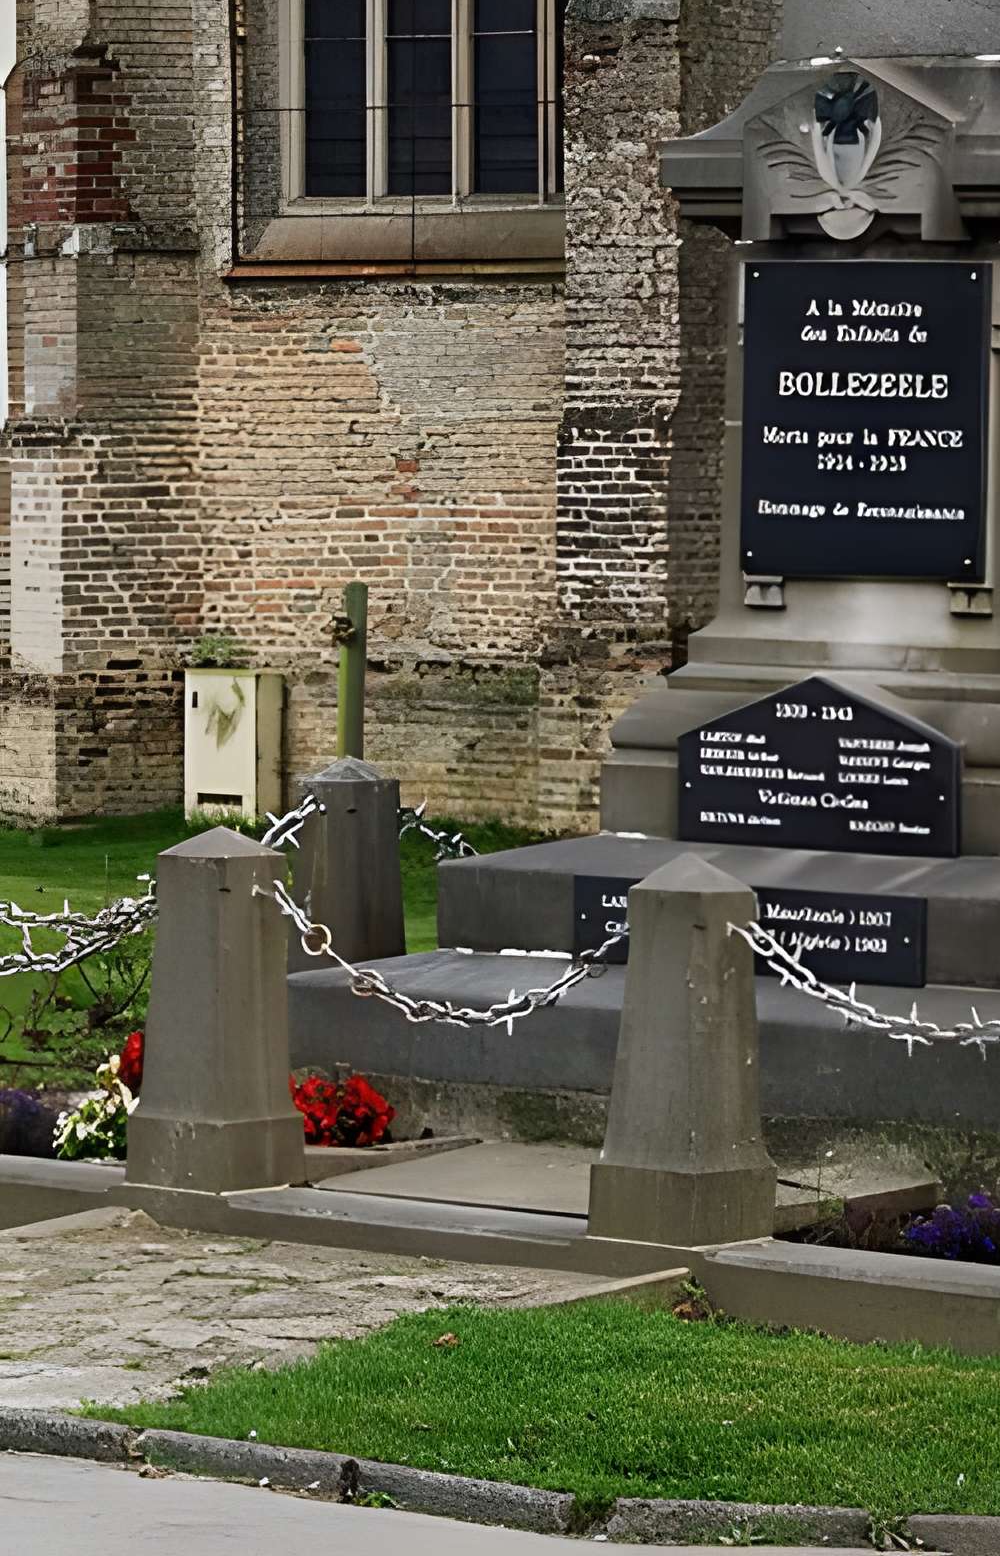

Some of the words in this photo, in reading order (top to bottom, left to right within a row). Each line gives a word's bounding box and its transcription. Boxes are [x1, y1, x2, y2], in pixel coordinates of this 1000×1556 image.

[806, 299, 820, 316] A
[779, 371, 948, 399] BOLLEZEELE
[888, 428, 963, 448] FRANCE
